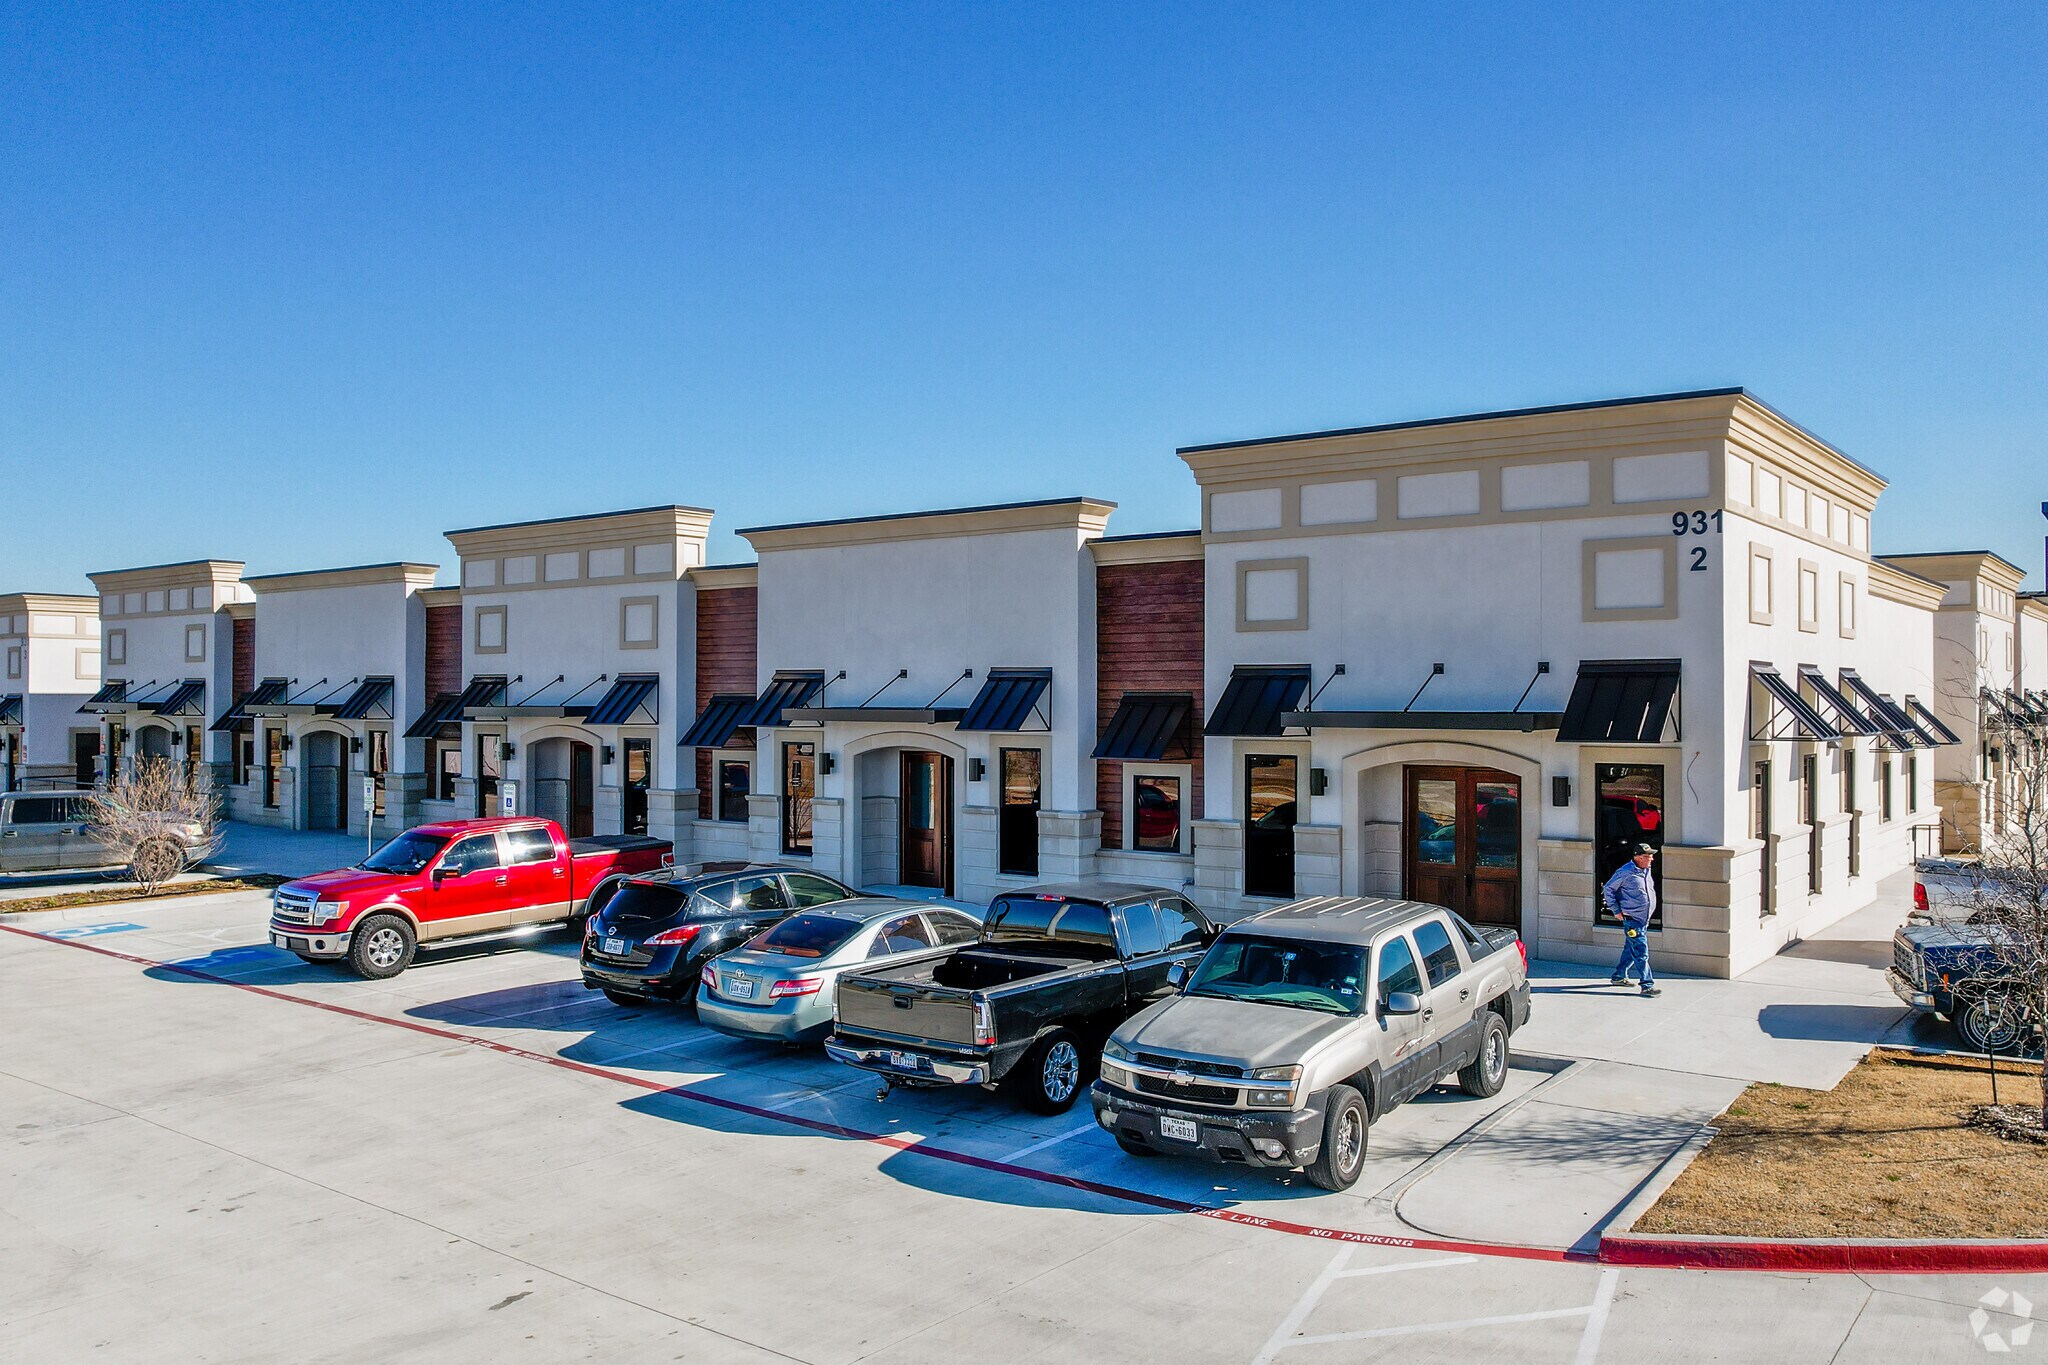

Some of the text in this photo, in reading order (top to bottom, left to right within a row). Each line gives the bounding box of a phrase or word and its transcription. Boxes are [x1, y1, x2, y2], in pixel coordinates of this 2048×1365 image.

[1672, 509, 1723, 536] 931
[1690, 546, 1708, 571] 2
[1189, 1206, 1415, 1247] FIRE LANE NO PARKING
